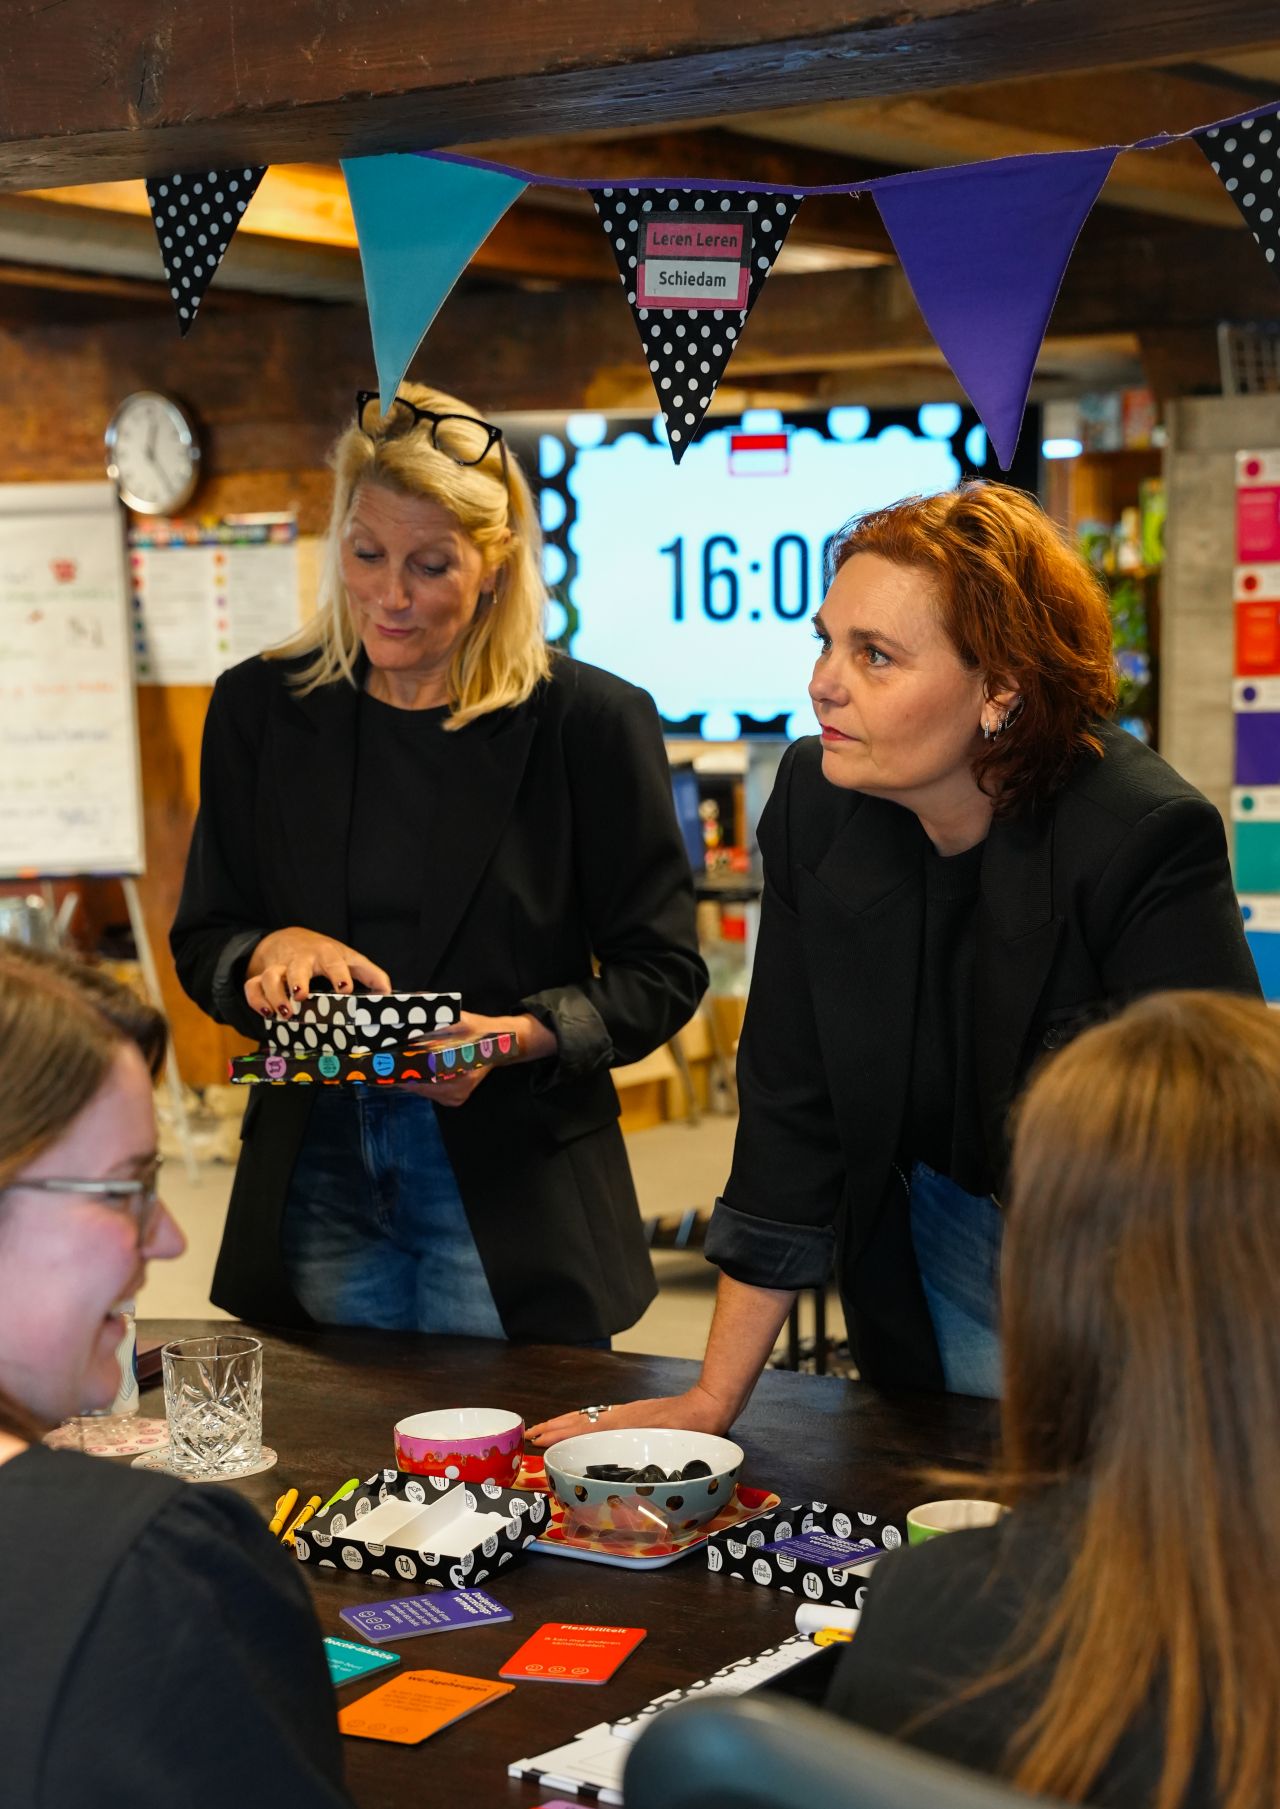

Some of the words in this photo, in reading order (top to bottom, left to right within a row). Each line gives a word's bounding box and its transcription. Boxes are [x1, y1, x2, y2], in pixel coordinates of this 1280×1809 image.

[652, 231, 692, 246] Leren
[696, 232, 738, 248] Leren
[659, 270, 727, 287] Schiedam
[659, 534, 836, 623] 16:0
[560, 1624, 628, 1634] Flexibiliteit
